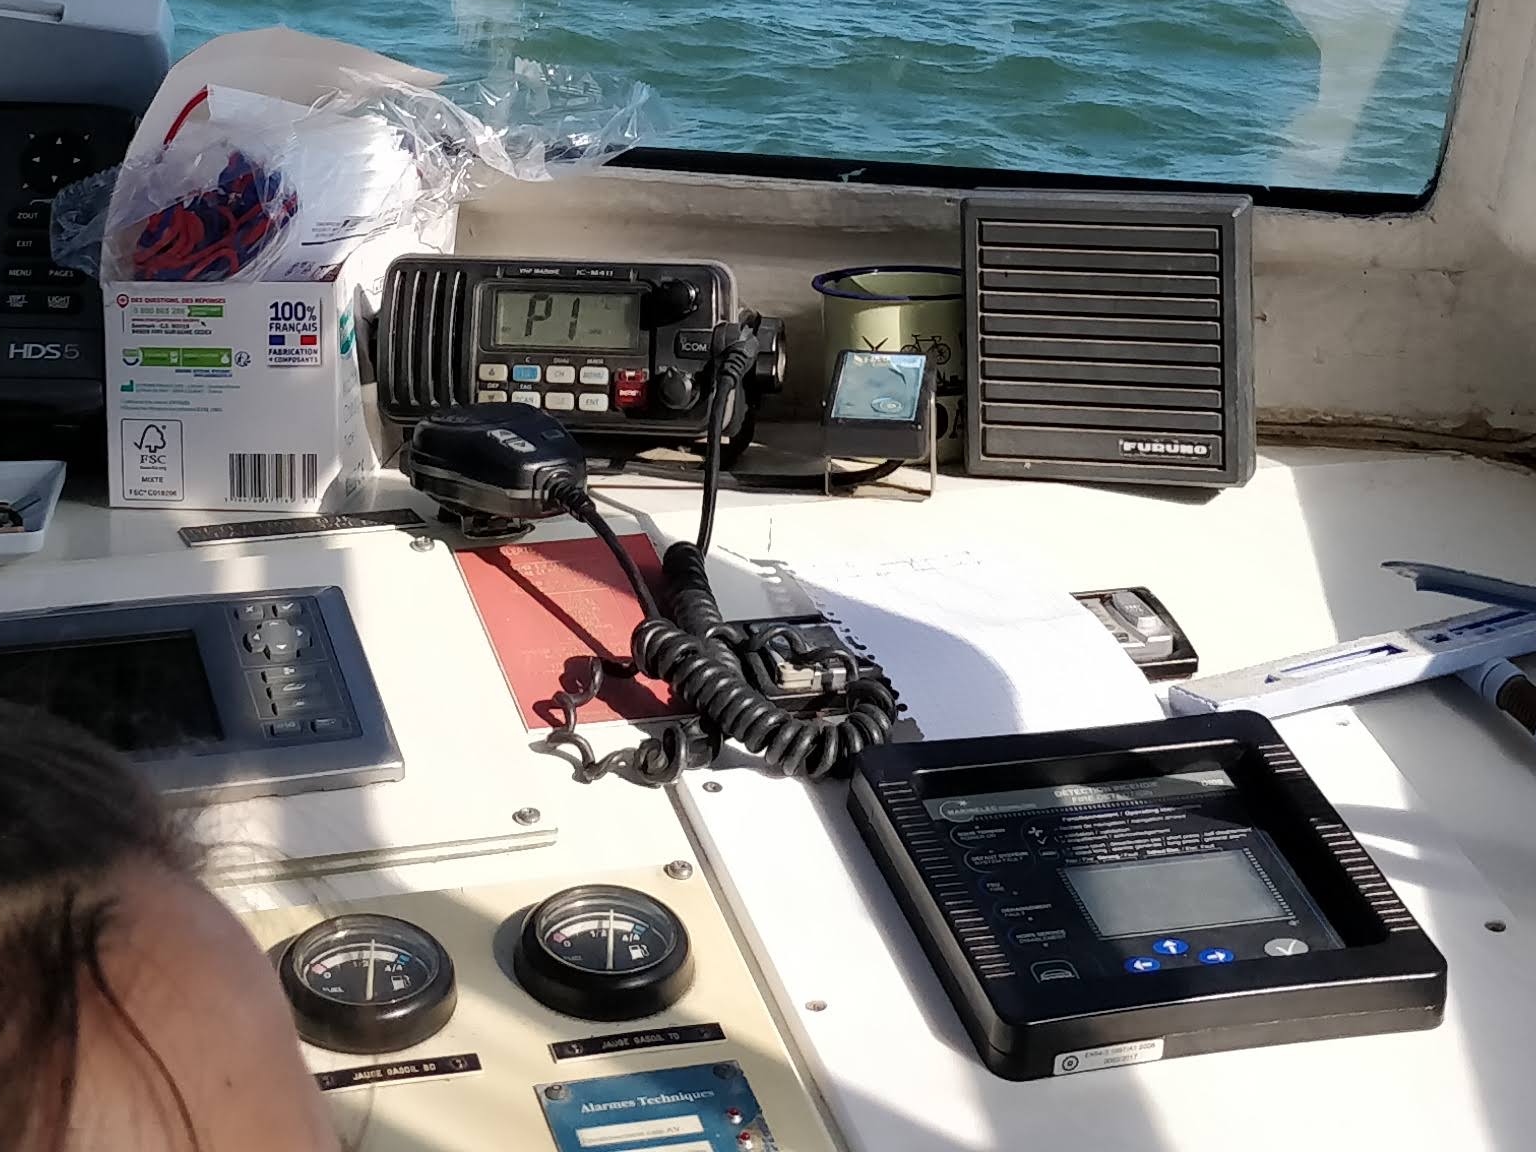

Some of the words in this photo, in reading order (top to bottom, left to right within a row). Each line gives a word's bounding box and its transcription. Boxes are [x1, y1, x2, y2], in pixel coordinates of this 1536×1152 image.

[16, 211, 38, 220] ZOUT
[16, 239, 33, 248] EXIT
[8, 269, 32, 278] MENU
[48, 269, 74, 278] PAGES
[269, 301, 317, 322] 100%
[268, 322, 318, 334] FRANÇAIS
[268, 348, 318, 356] FABRICATION
[1122, 442, 1207, 454] FURUNO
[139, 454, 167, 465] FSC
[141, 476, 164, 484] MIXTE
[601, 1038, 629, 1050] JAUGE
[634, 1034, 665, 1046] GASOIL
[351, 1069, 383, 1082] JAUGE
[387, 1065, 420, 1078] GASOIL
[581, 1100, 635, 1114] Alarmes
[638, 1089, 715, 1107] Techniques
